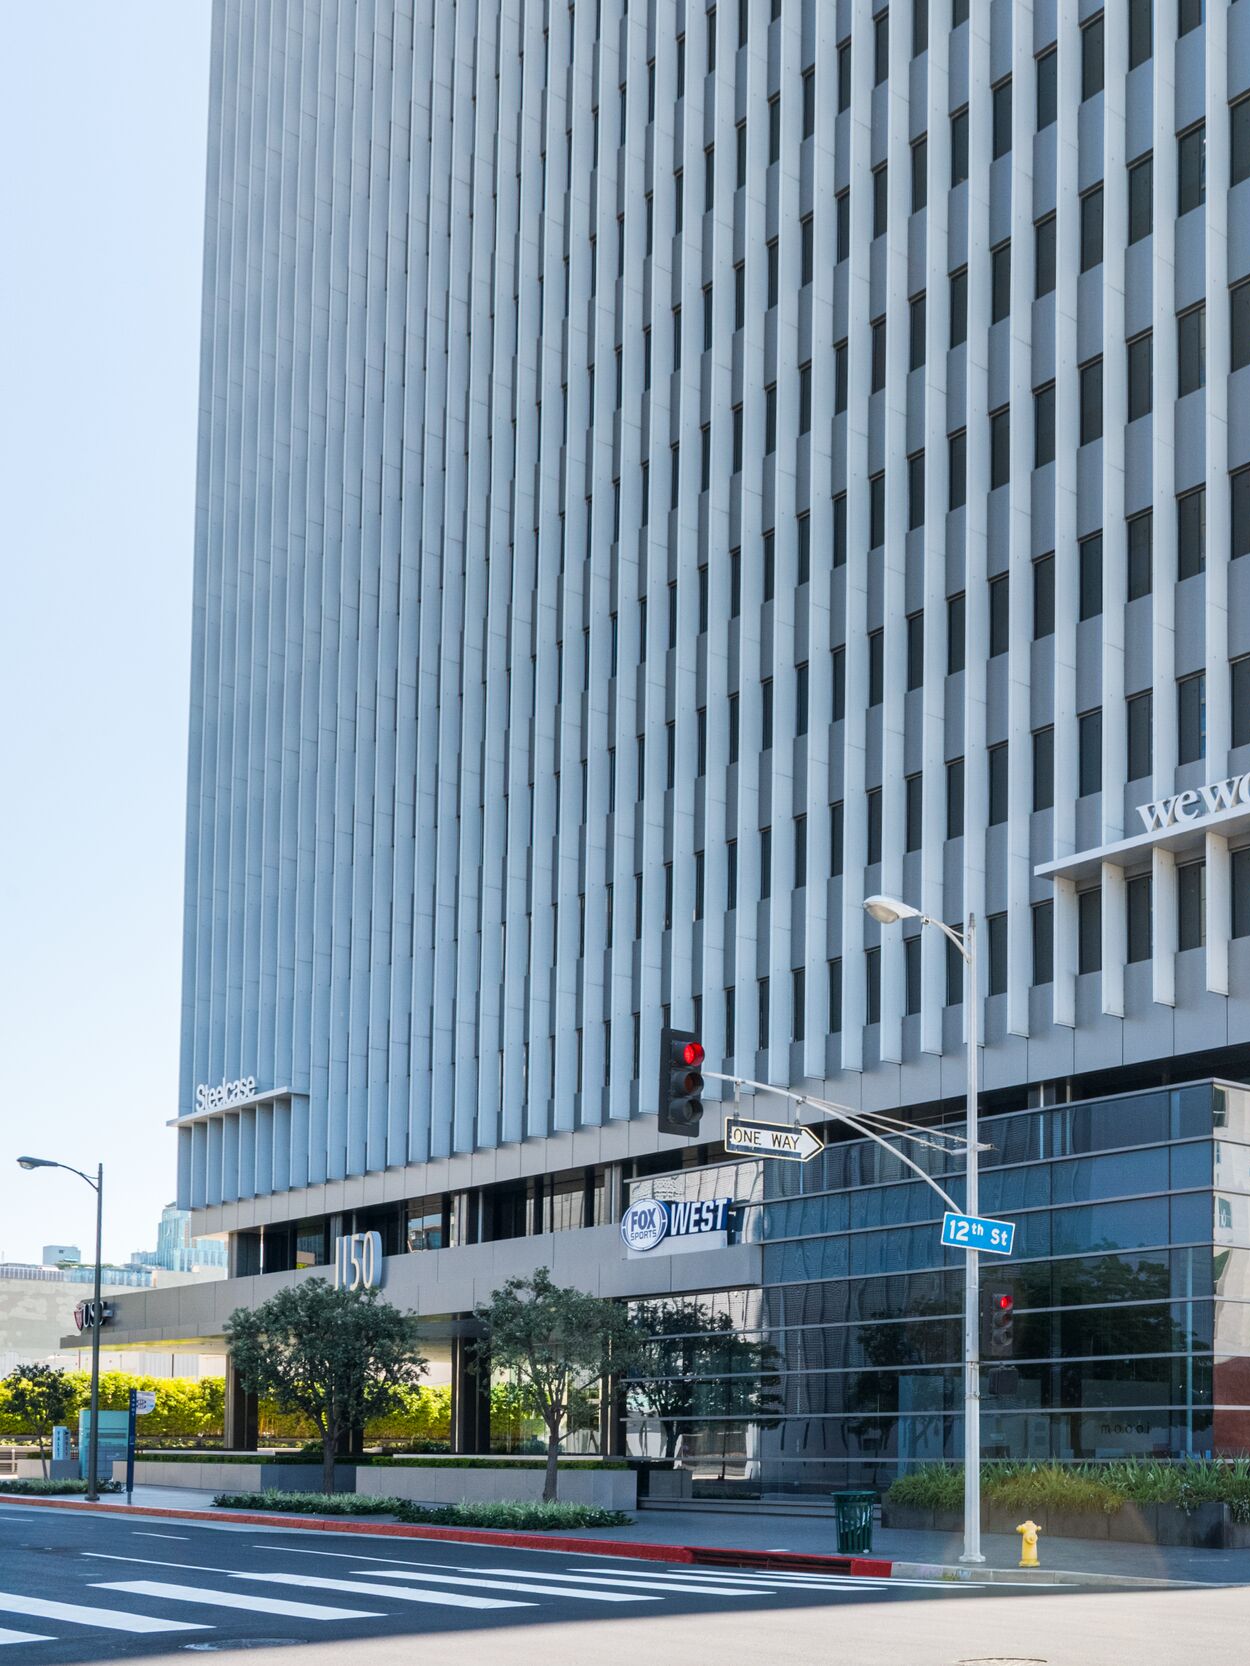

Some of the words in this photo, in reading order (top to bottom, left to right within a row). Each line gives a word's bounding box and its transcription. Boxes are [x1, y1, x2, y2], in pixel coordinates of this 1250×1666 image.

[196, 1076, 256, 1111] Steelcase
[733, 1127, 762, 1146] ONE
[770, 1132, 800, 1151] WAY
[630, 1207, 657, 1232] FOX
[670, 1199, 728, 1237] WEST
[630, 1228, 658, 1241] SPORTS
[949, 1219, 984, 1242] 12th
[990, 1227, 1008, 1247] St
[333, 1230, 383, 1292] 1150
